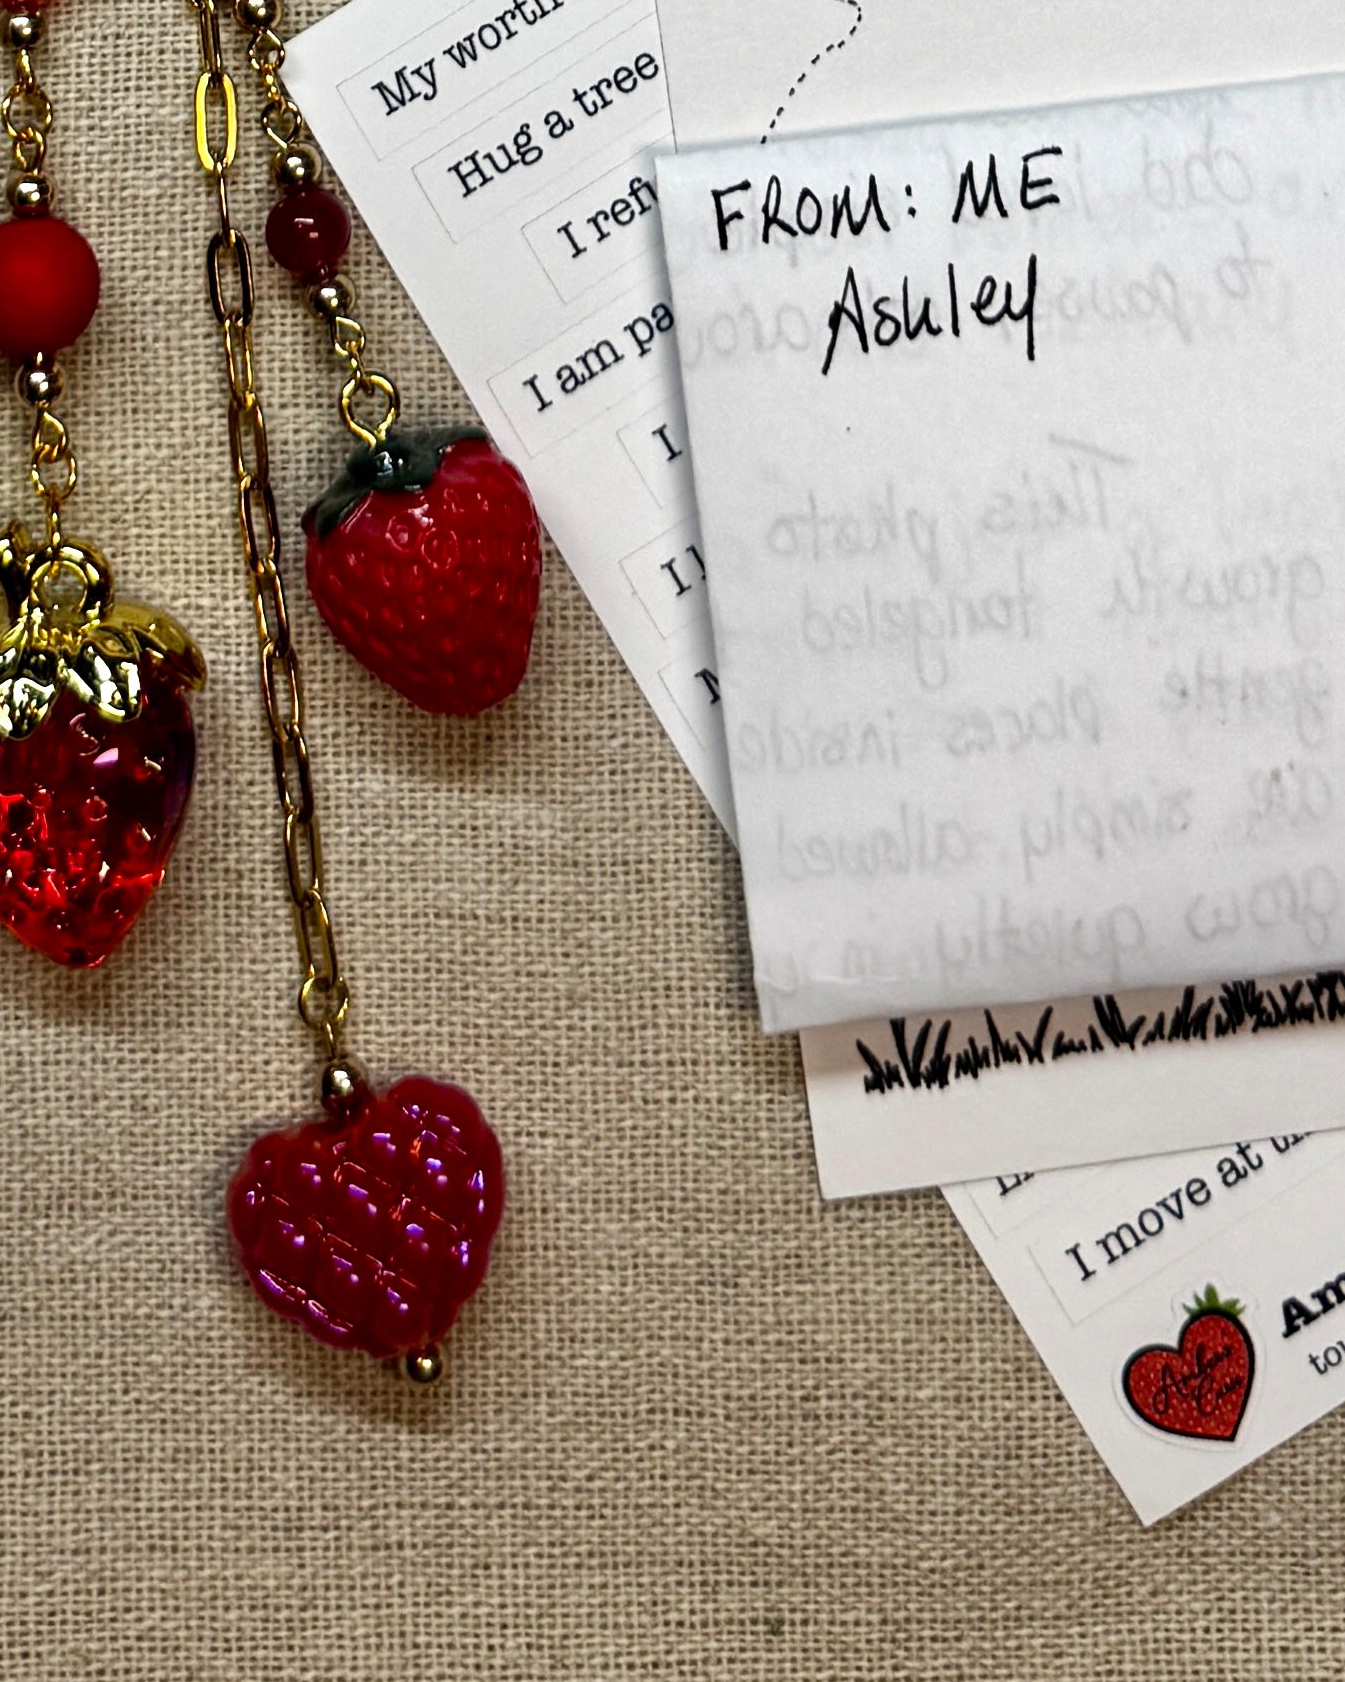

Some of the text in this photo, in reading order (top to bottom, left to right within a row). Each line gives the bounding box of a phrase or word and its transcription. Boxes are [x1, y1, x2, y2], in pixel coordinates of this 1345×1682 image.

[370, 56, 437, 117] My
[446, 51, 660, 199] Hug a tree
[710, 145, 1063, 252] FROM: ME
[556, 220, 587, 260] I
[820, 252, 1038, 377] Ashley
[521, 373, 554, 413] I
[554, 335, 625, 396] am
[650, 422, 683, 463] I
[660, 557, 693, 598] I
[1065, 1242, 1096, 1283] I
[1094, 1175, 1213, 1266] move
[1215, 1141, 1264, 1190] at
